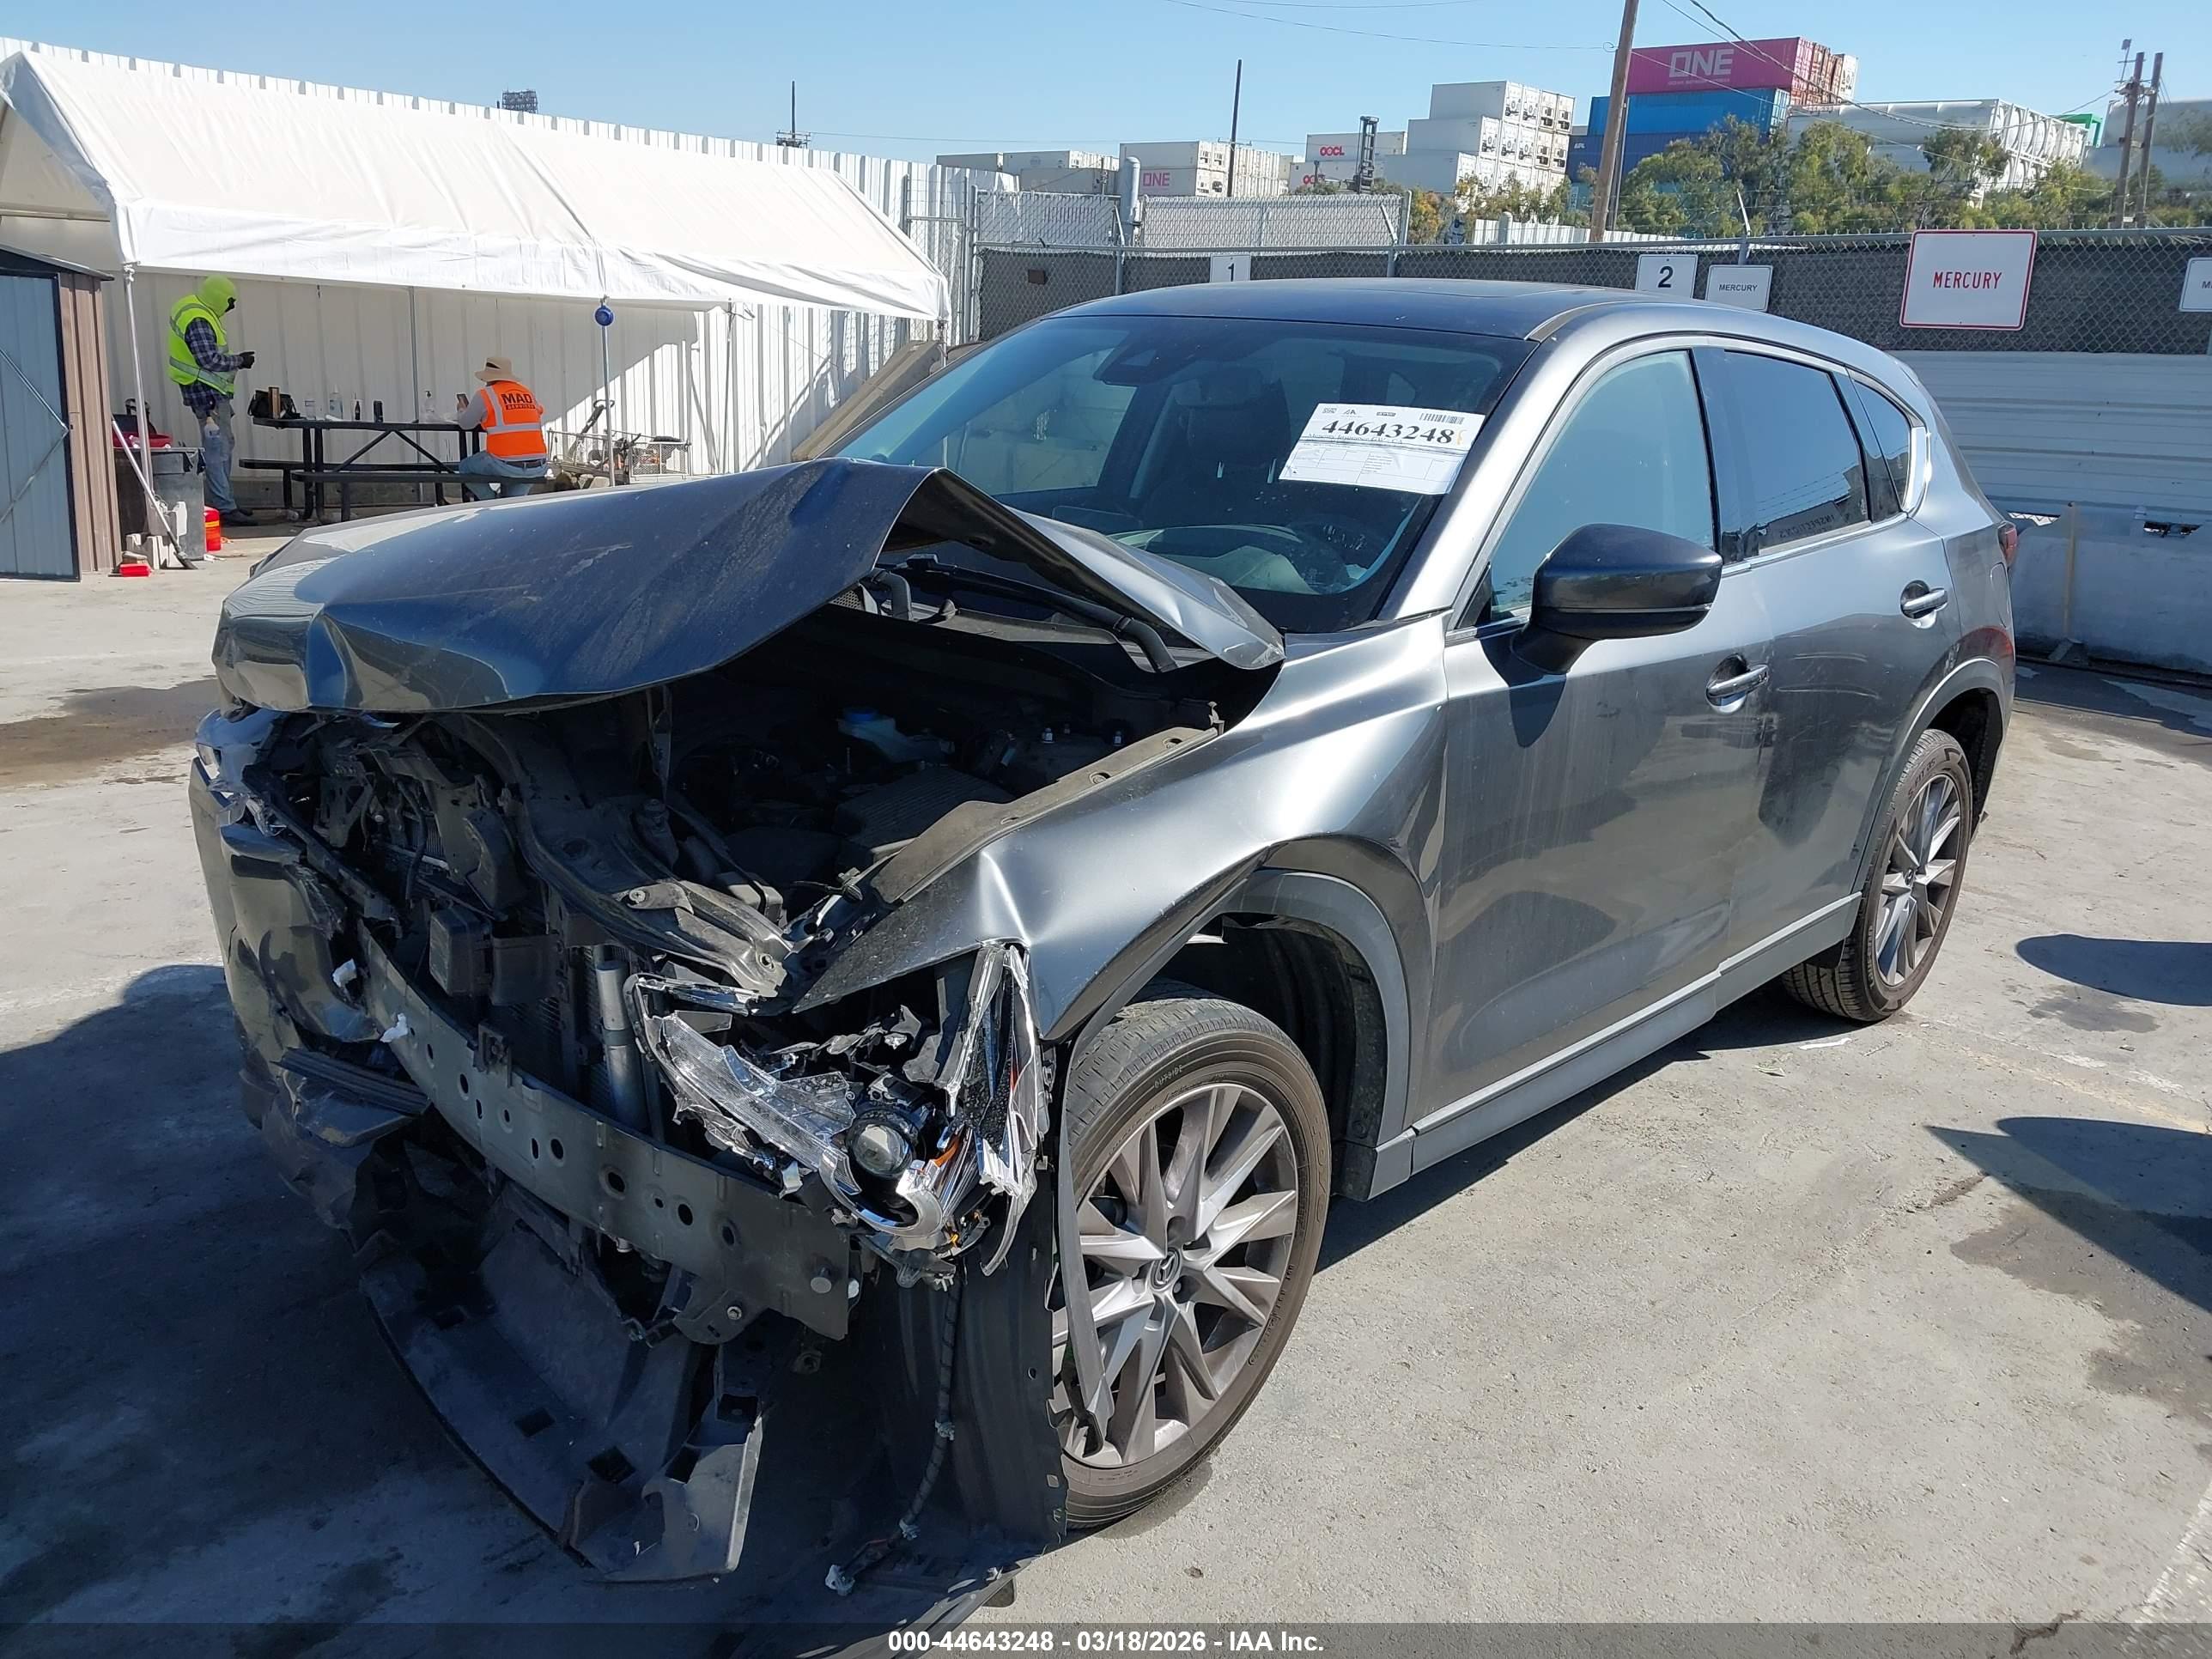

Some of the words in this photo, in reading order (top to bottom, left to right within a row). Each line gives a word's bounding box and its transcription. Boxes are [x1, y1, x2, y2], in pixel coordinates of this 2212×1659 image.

[1668, 49, 1734, 77] ONE
[1320, 146, 1344, 155] OOCL
[1143, 173, 1170, 185] ONE
[1228, 263, 1234, 282] 1
[1657, 265, 1674, 288] 2
[1933, 271, 2002, 289] MERCURY
[1718, 283, 1758, 292] MERCURY
[501, 392, 532, 404] MAD
[1322, 420, 1454, 444] 44643248
